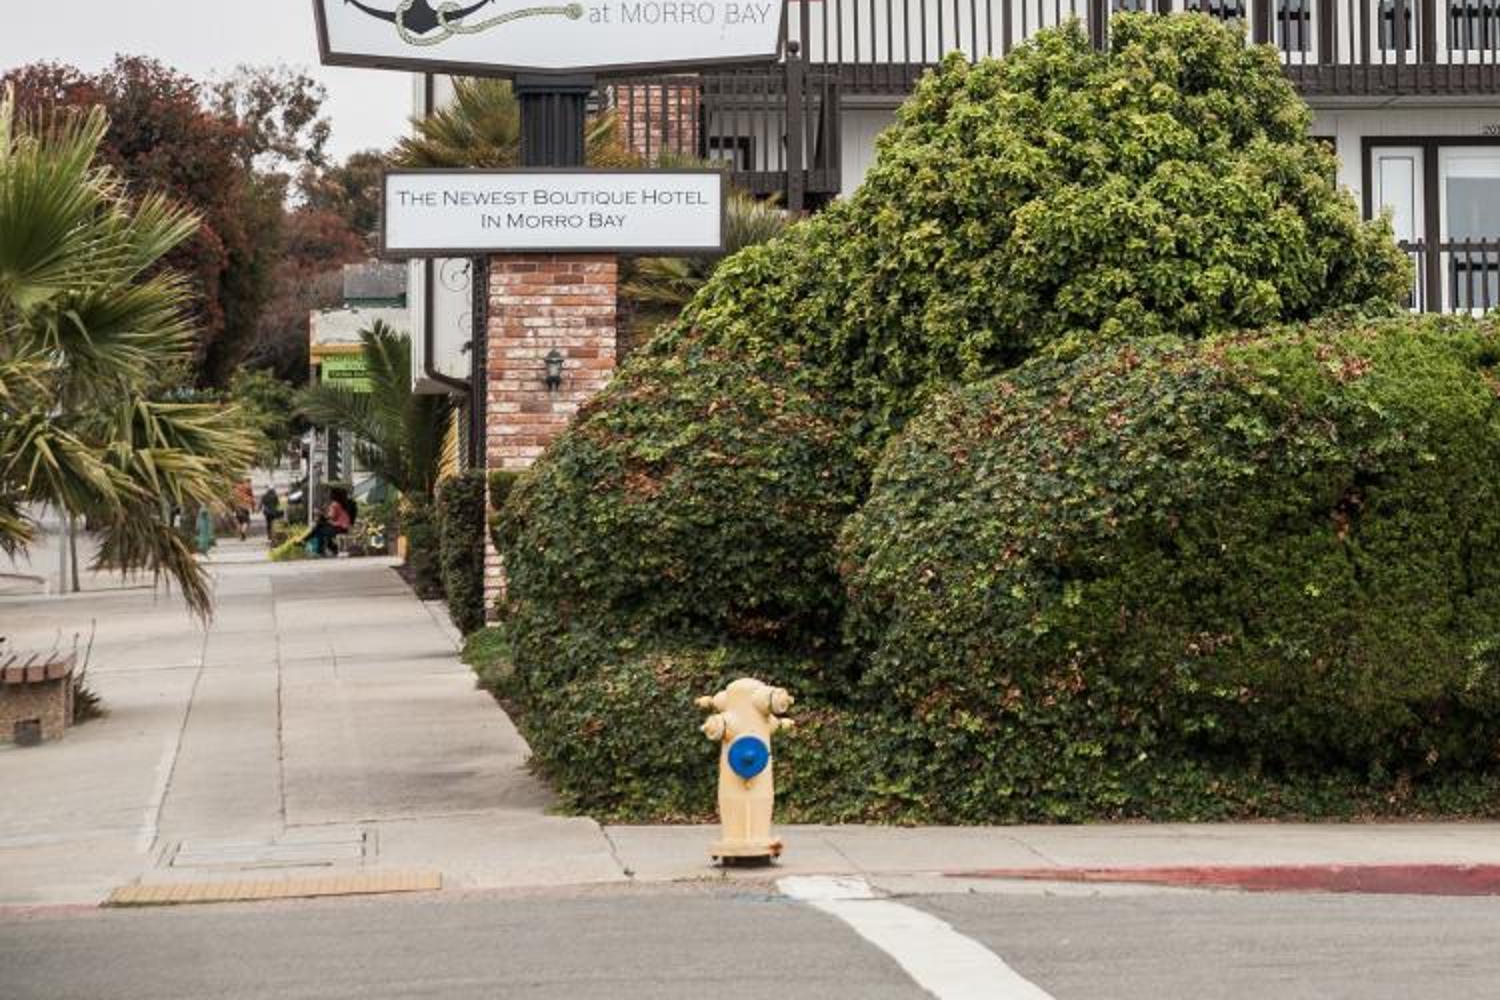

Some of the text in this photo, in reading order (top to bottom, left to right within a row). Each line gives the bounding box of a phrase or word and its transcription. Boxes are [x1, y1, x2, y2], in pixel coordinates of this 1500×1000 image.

[588, 0, 772, 25] at MORRO BAY
[396, 188, 710, 206] THE NEWEST BOUTIQUE HOTEL
[480, 212, 627, 229] IN MORRO BAY
